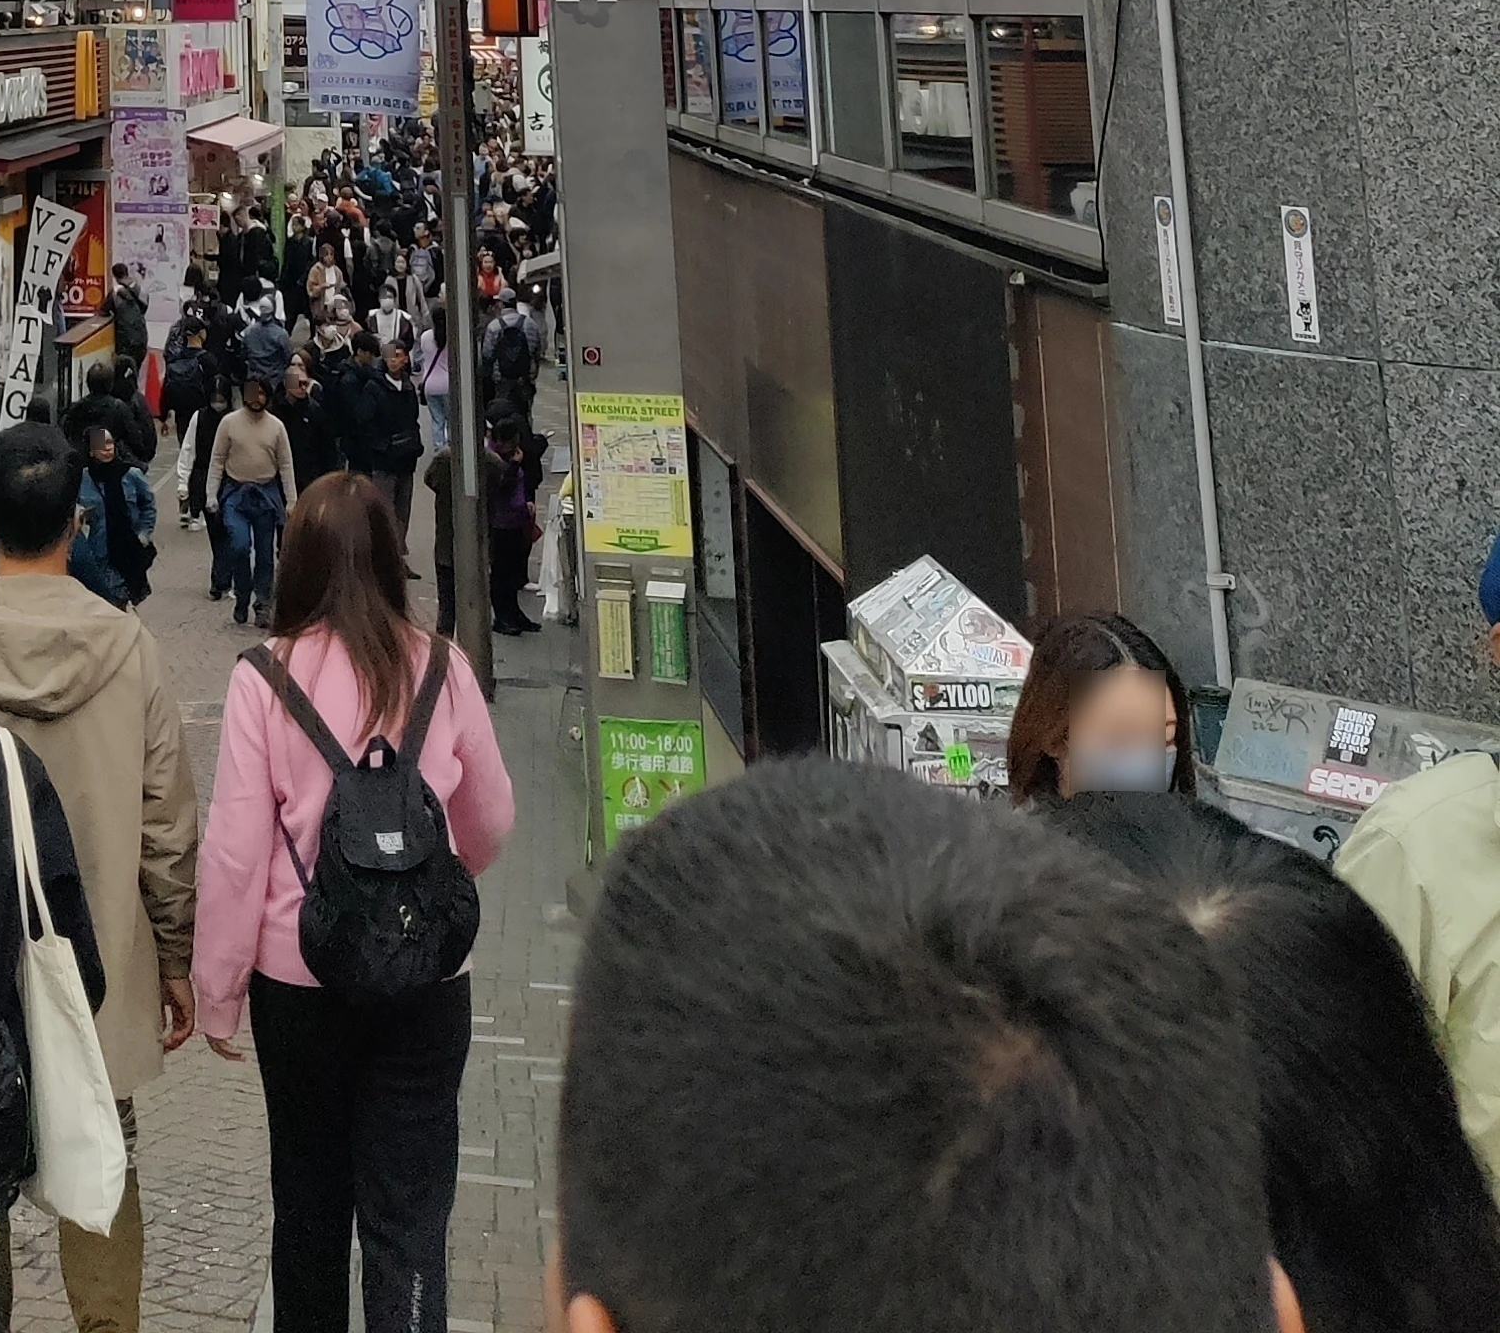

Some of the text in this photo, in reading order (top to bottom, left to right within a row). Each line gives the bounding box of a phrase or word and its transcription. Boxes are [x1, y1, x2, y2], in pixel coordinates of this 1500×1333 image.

[580, 404, 681, 417] TAKESHITA STREET
[1338, 707, 1377, 726] MOMS
[1334, 719, 1373, 737] BODY
[1331, 730, 1371, 747] SHOP
[611, 753, 694, 774] 歩行者用道路
